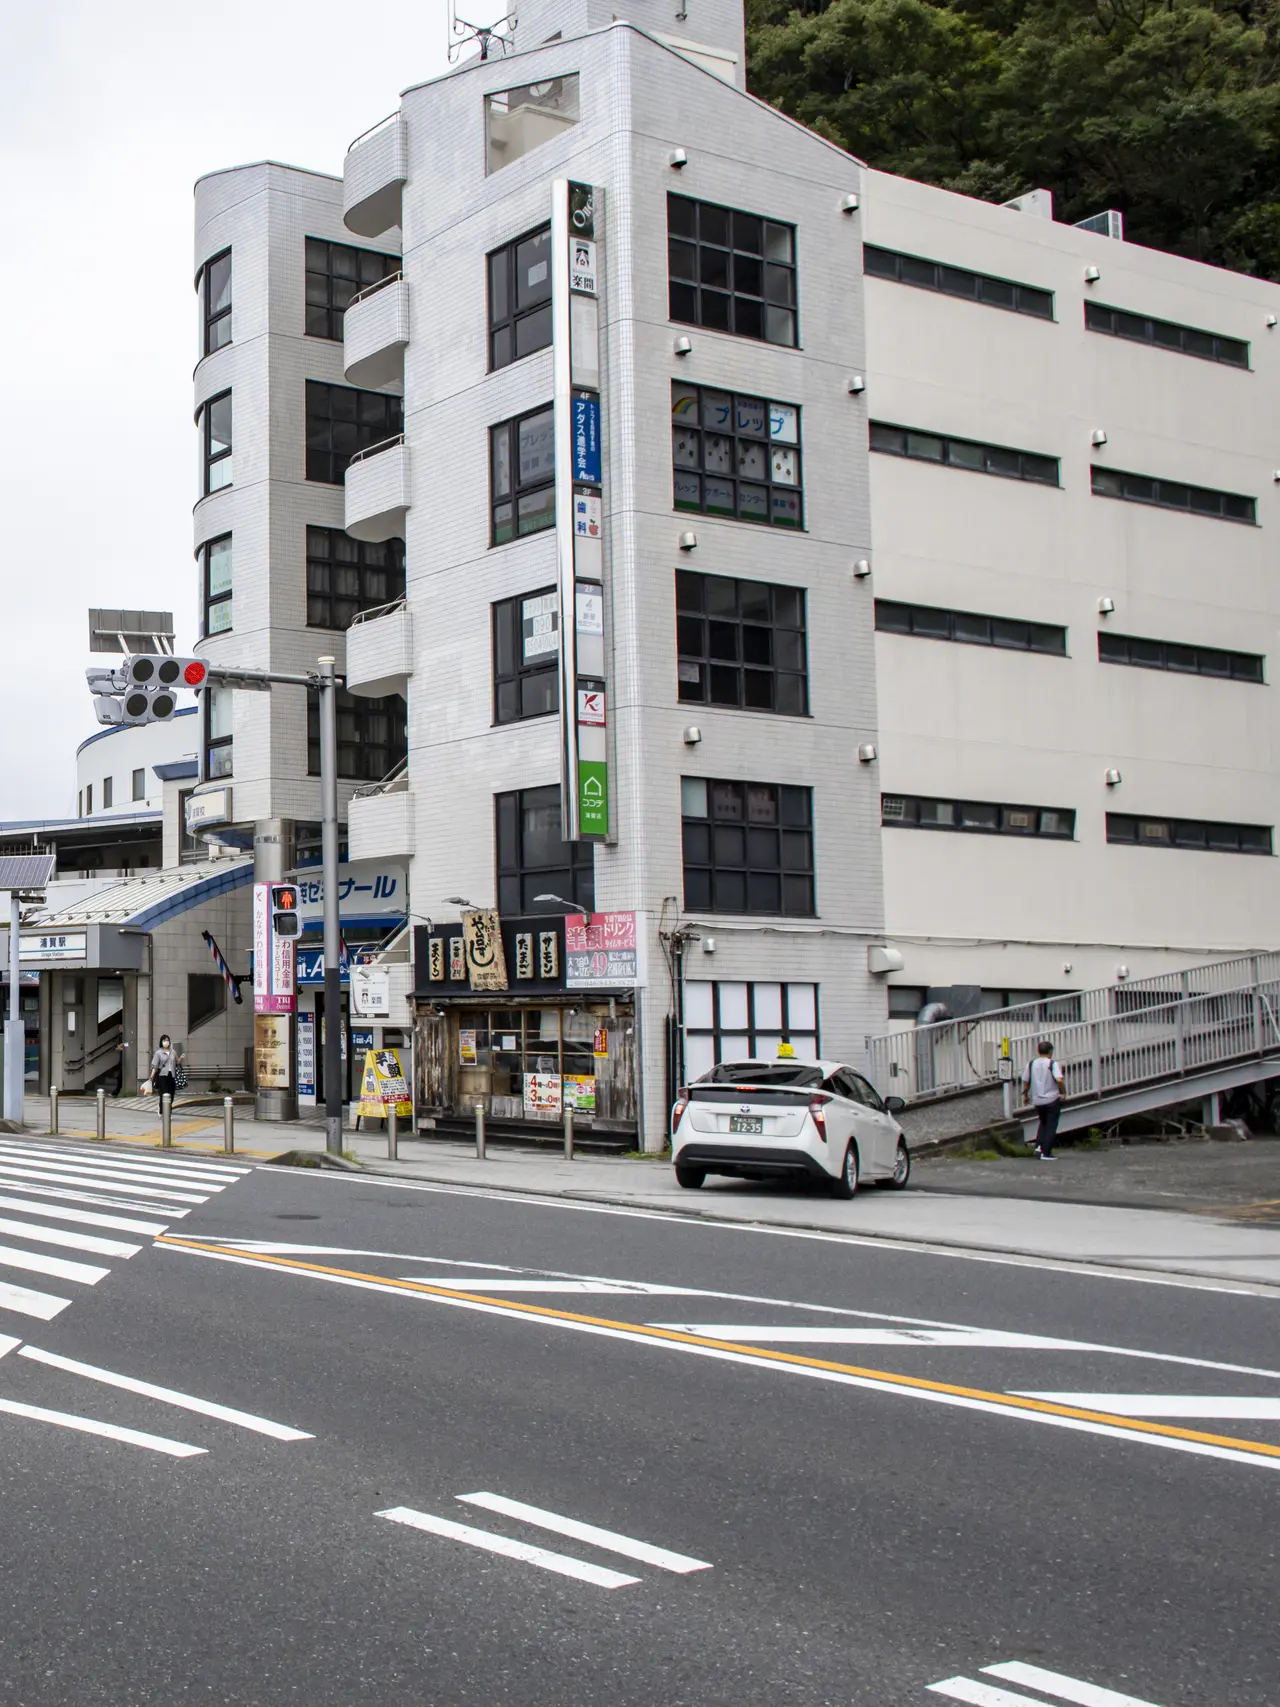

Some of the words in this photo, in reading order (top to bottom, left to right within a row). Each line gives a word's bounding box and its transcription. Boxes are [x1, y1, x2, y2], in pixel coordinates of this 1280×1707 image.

[580, 392, 590, 400] 4F
[715, 406, 785, 434] プレップ
[584, 585, 594, 593] 2F
[582, 799, 604, 807] ココデ
[604, 922, 634, 936] ドリンク
[40, 937, 66, 948] 浦賀駅
[567, 925, 603, 950] 半額
[431, 942, 440, 978] まぐろ
[517, 938, 529, 975] たまご
[542, 936, 553, 974] サーモン
[737, 1122, 761, 1133] 12-35
